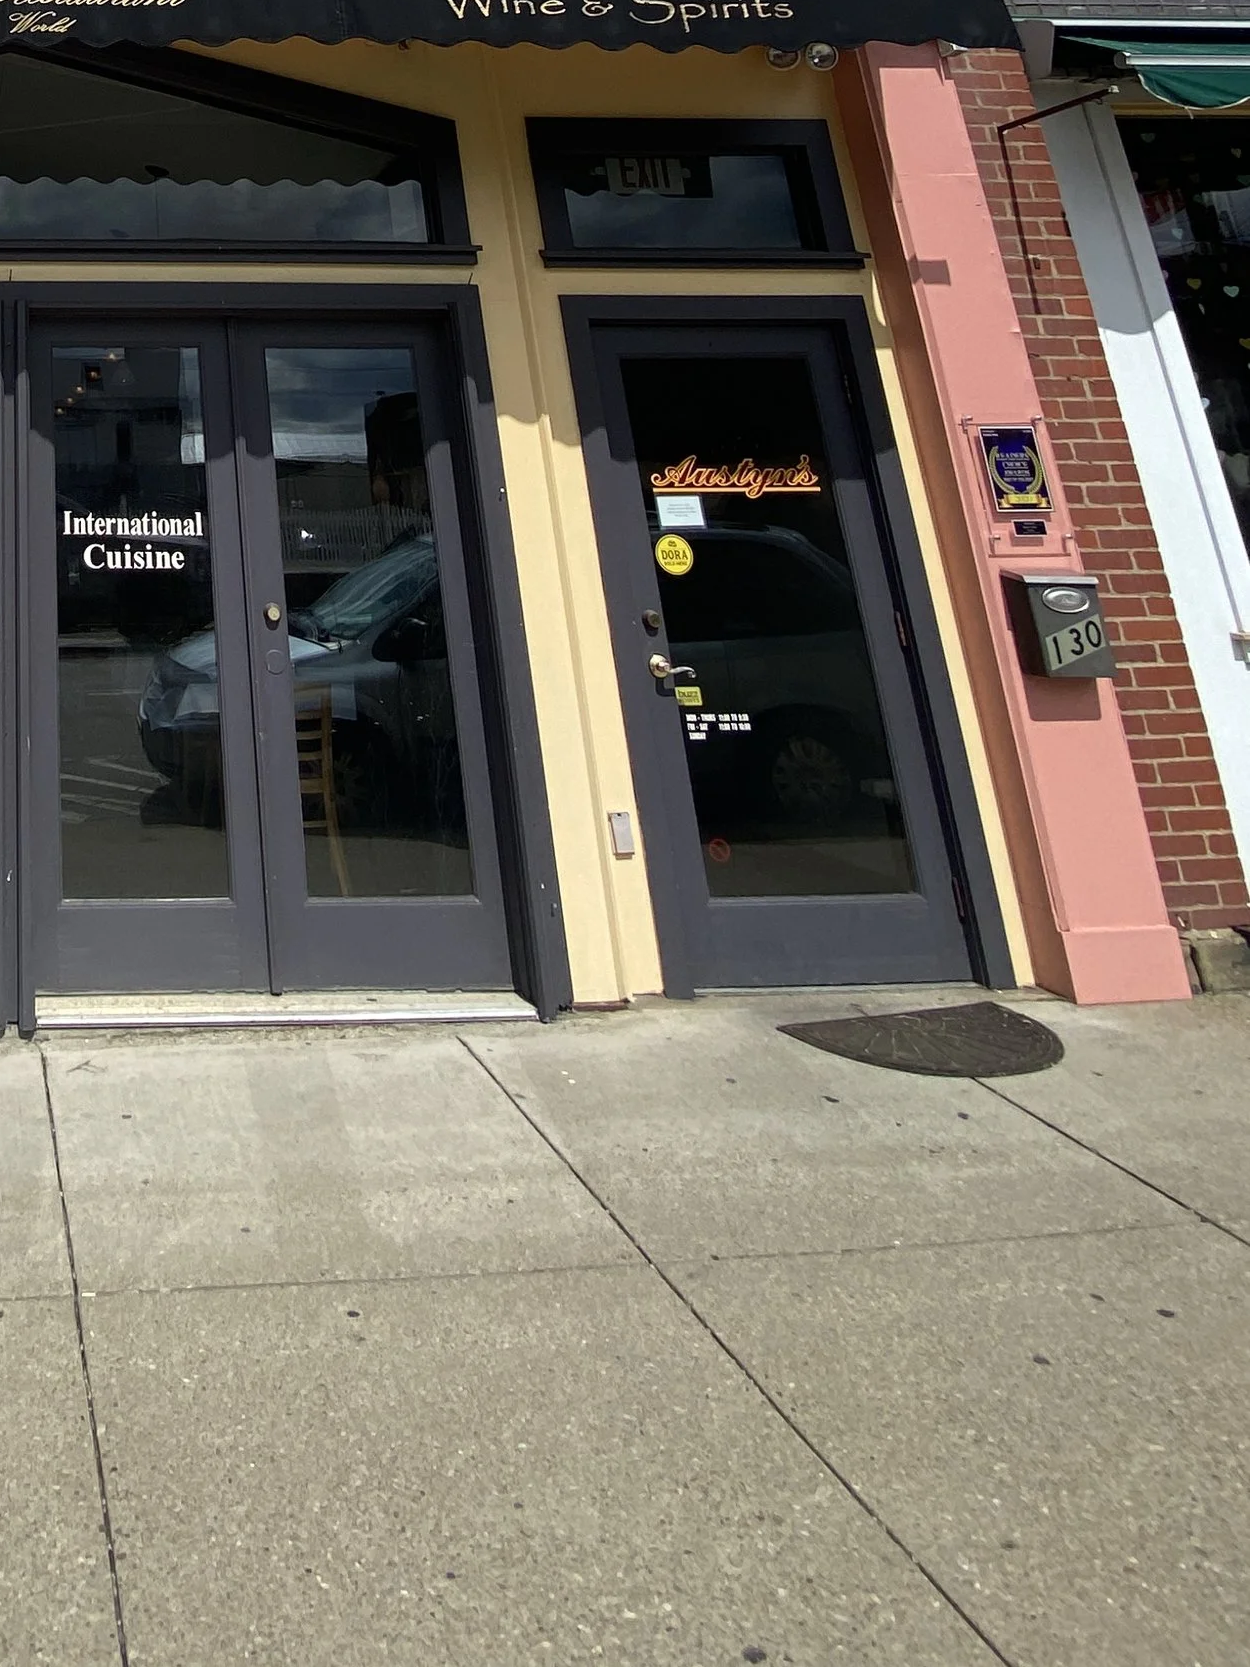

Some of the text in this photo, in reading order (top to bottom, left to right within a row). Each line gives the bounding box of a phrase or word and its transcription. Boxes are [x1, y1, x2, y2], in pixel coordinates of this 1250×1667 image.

[7, 10, 78, 34] World
[650, 454, 819, 500] Austyn's
[62, 510, 204, 537] International
[83, 543, 185, 570] Cuisine
[661, 549, 689, 560] DORA
[1051, 620, 1102, 665] 130
